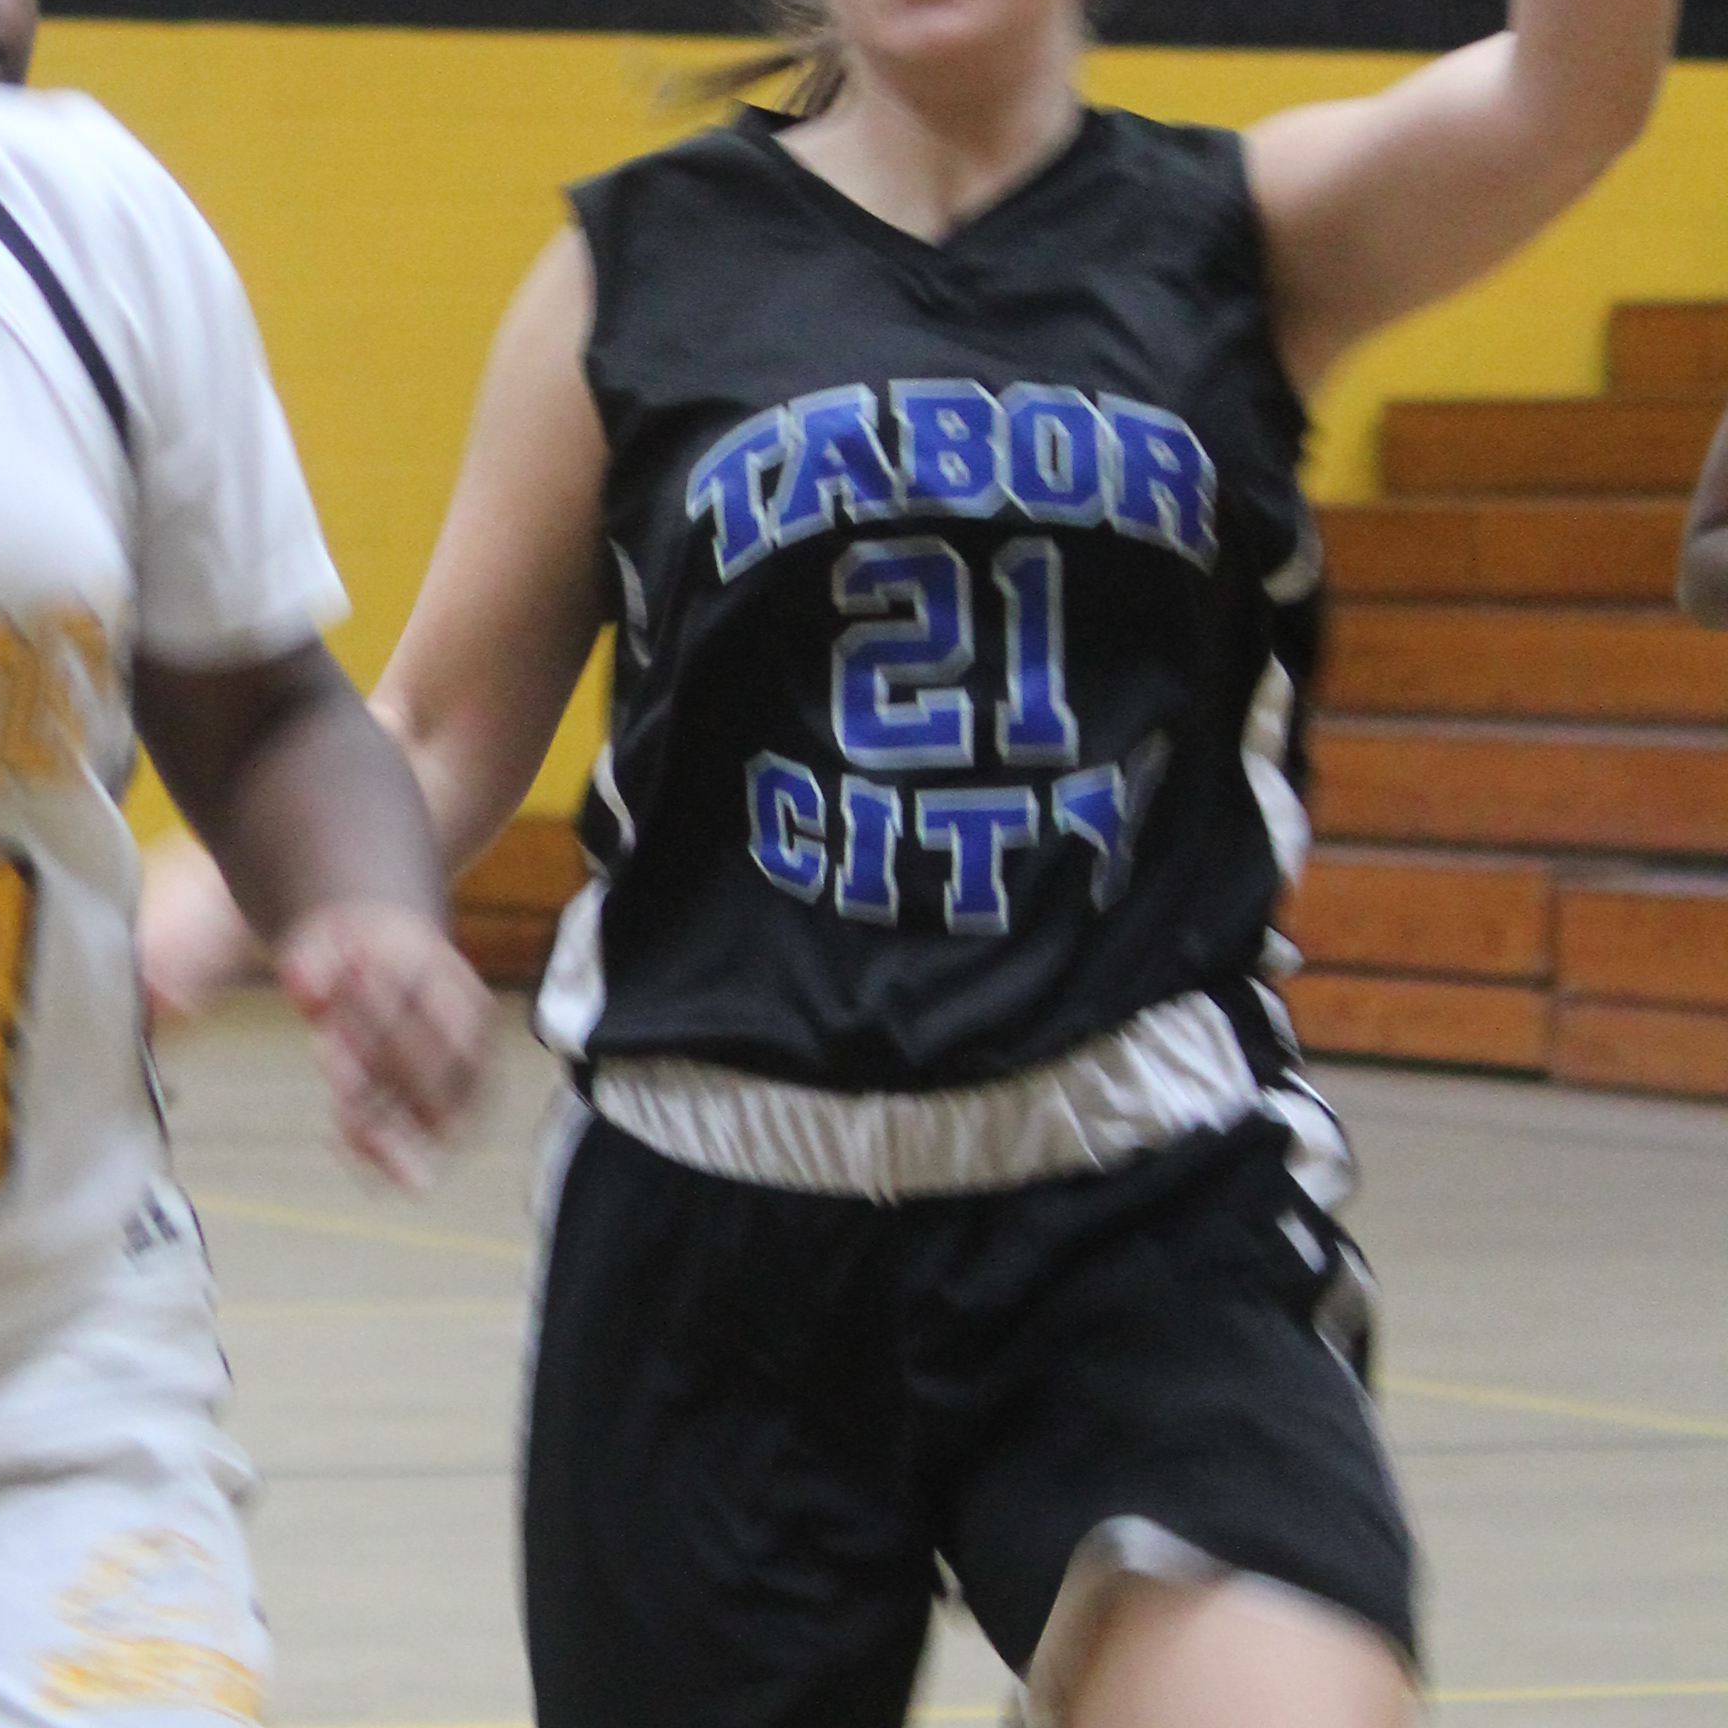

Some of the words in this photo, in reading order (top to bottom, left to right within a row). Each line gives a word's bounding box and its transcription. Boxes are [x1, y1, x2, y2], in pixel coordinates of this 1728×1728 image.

[685, 376, 1220, 586] TABOR
[832, 534, 1080, 772] 21
[744, 728, 1172, 936] CITY
